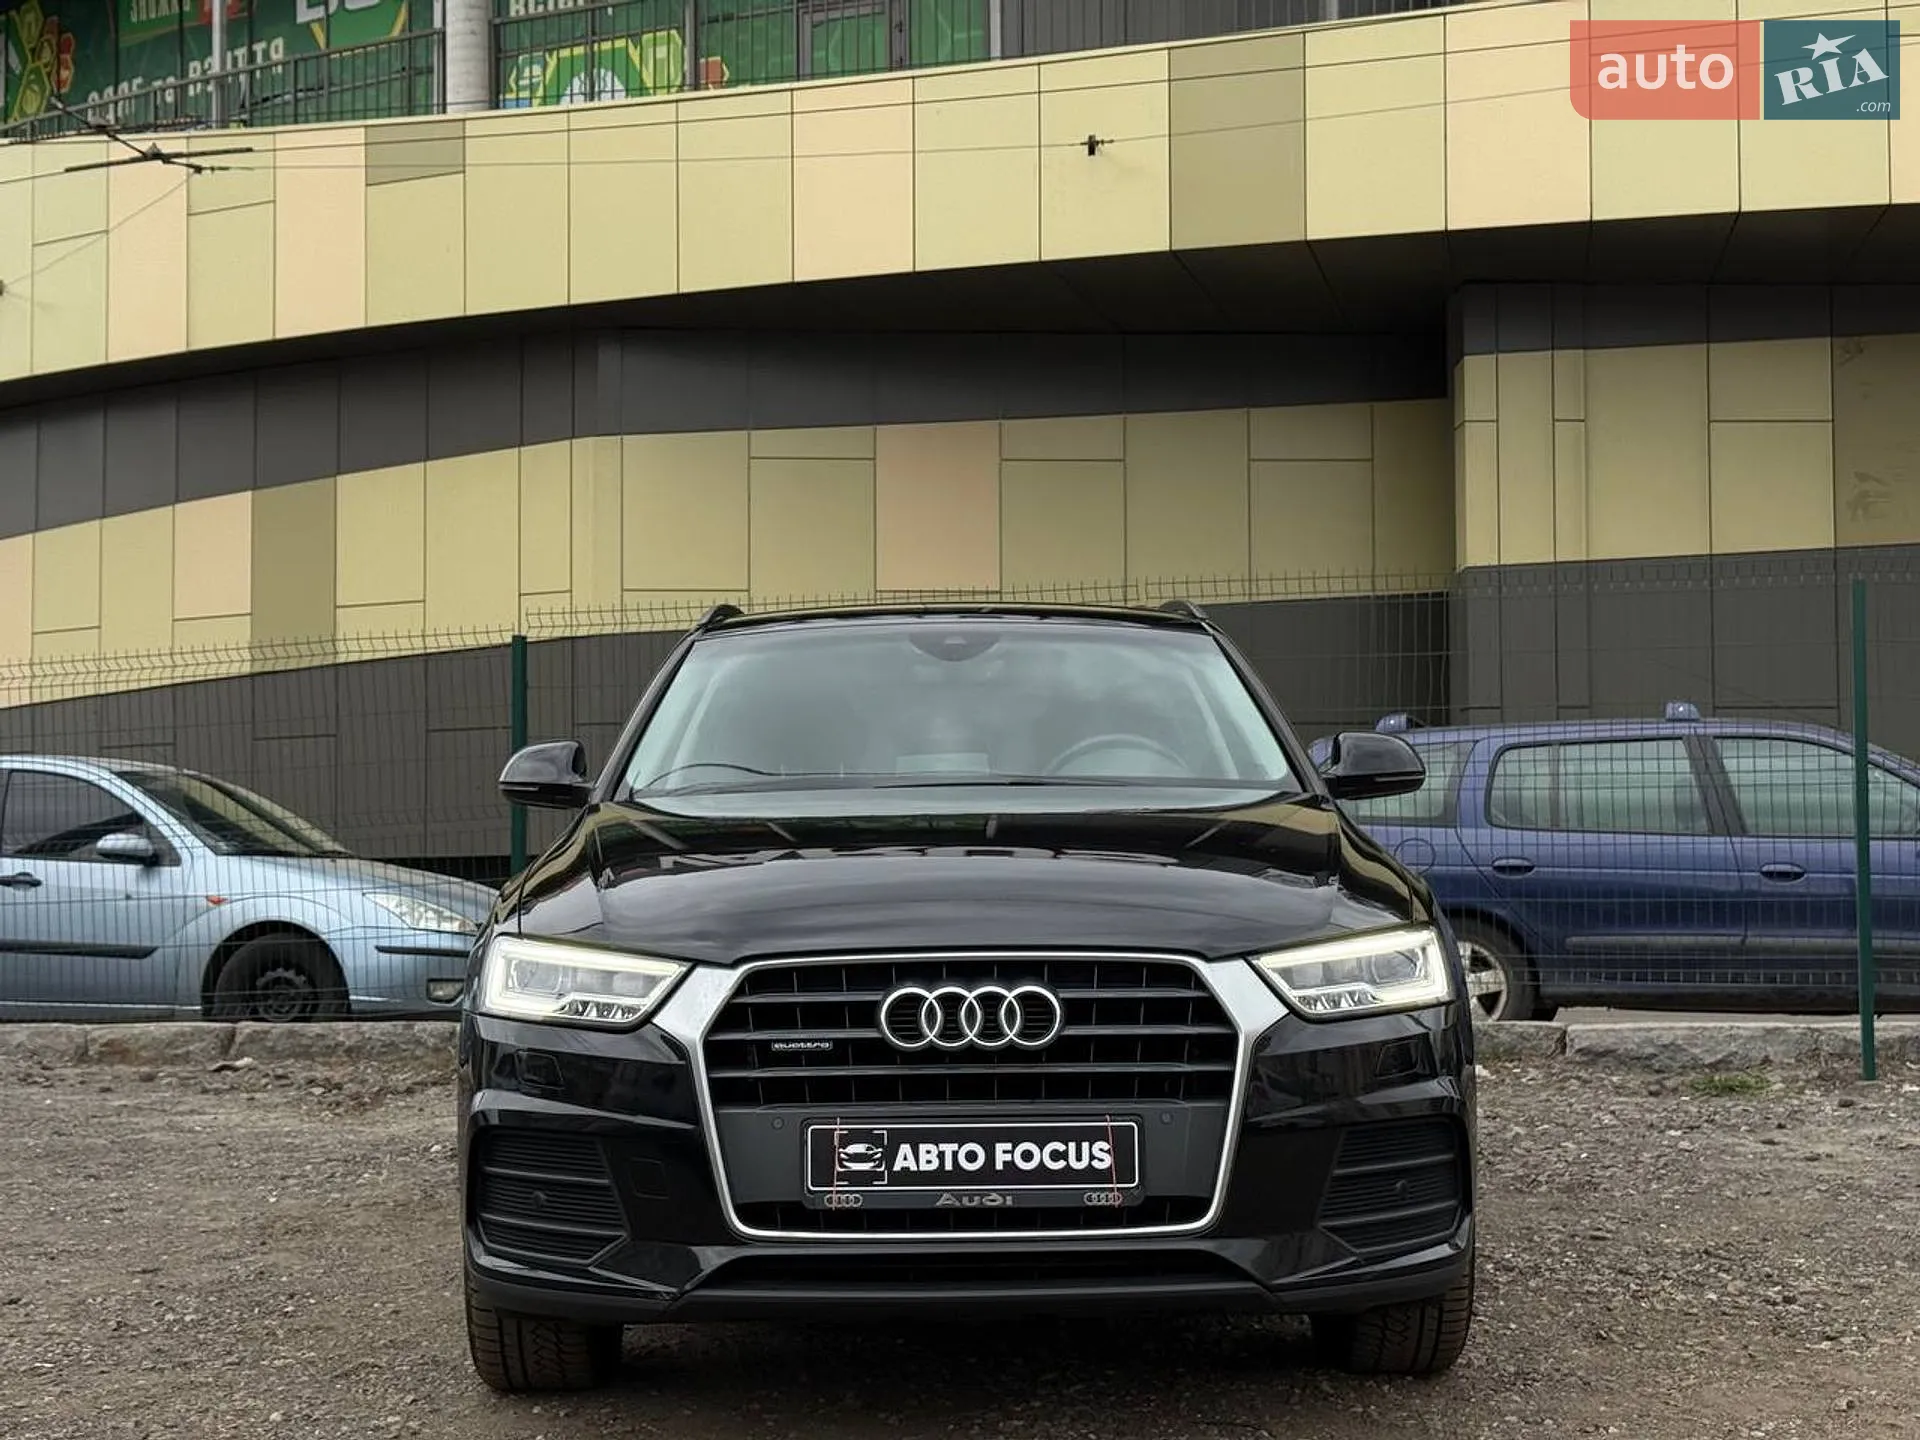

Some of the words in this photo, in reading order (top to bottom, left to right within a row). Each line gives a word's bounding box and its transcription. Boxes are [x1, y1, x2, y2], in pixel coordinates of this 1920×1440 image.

[893, 1142, 986, 1172] АВТО
[995, 1141, 1112, 1171] FOCUS
[936, 1192, 1013, 1206] Audi
